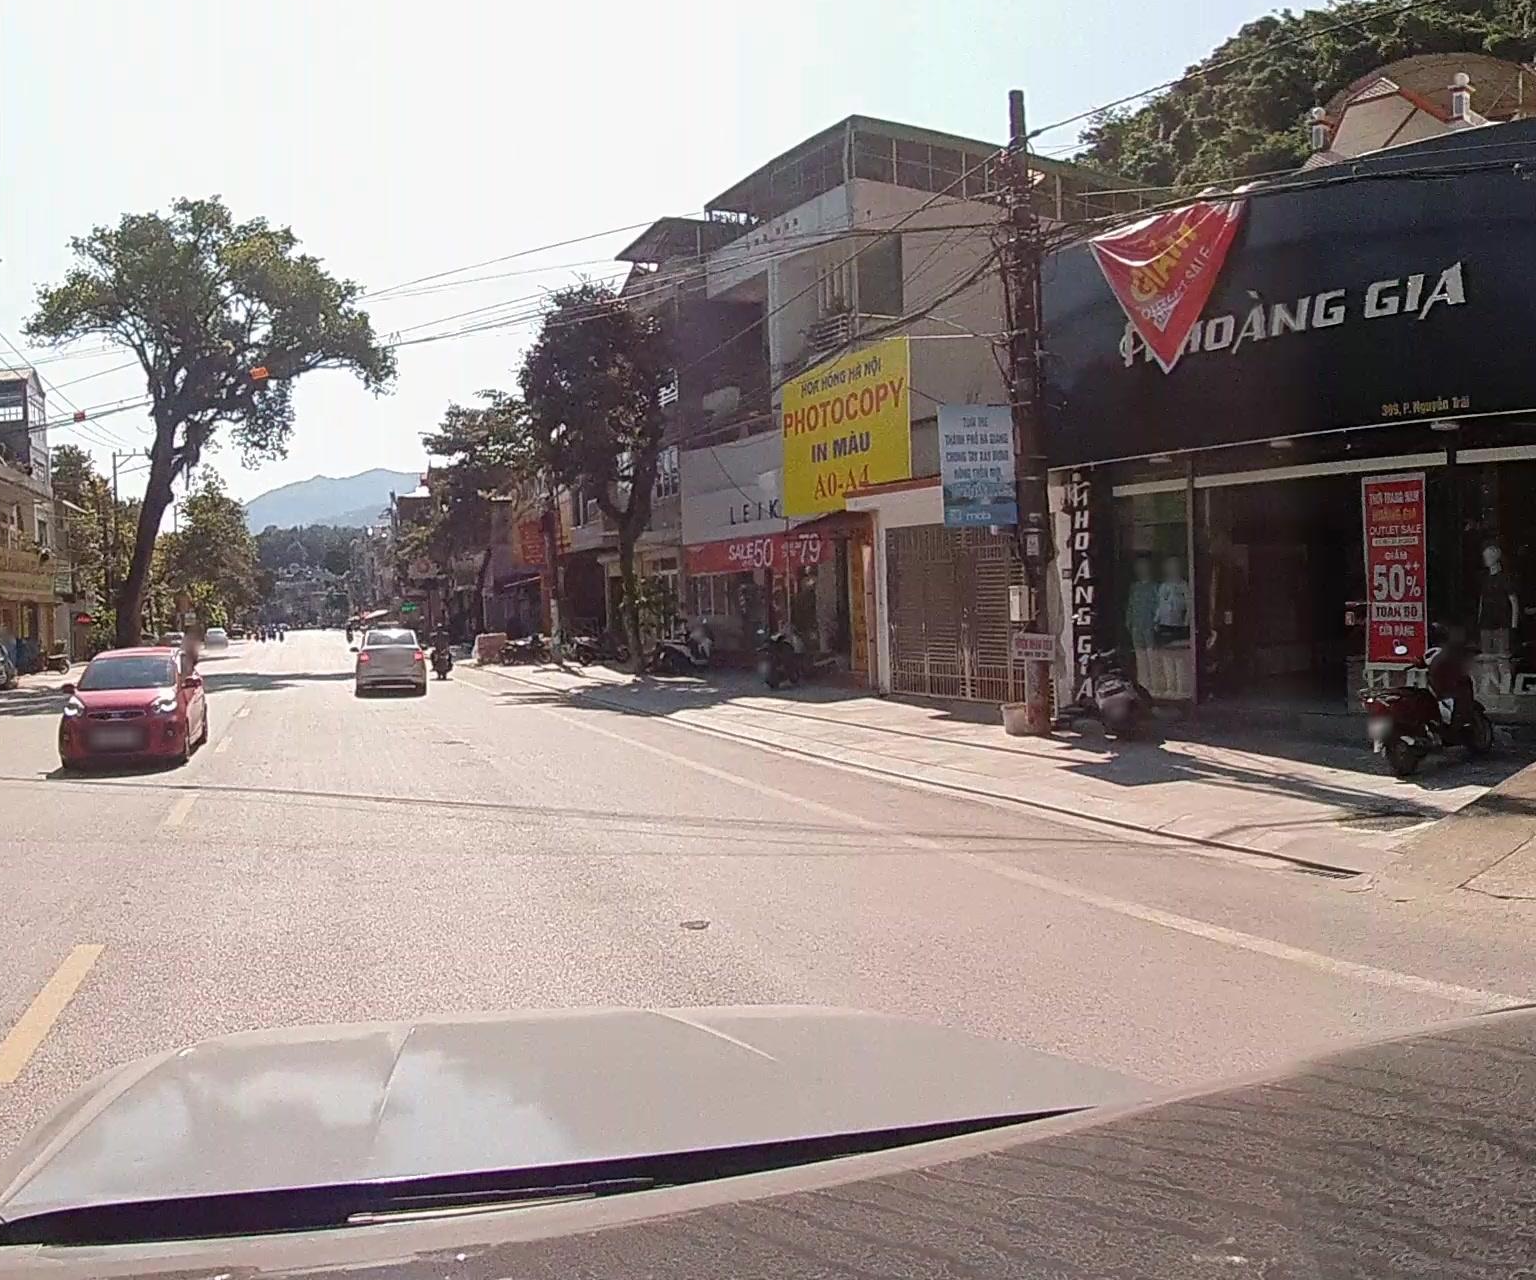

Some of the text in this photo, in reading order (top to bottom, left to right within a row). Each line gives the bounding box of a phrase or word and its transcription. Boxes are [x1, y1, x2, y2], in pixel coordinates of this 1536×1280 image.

[1363, 261, 1466, 320] GIA
[783, 377, 905, 439] PHOTOCOPY
[811, 441, 828, 464] IN
[1369, 523, 1422, 536] OUTLET SALE
[728, 542, 754, 561] SALE
[753, 538, 774, 568] 50
[799, 532, 822, 564] 79
